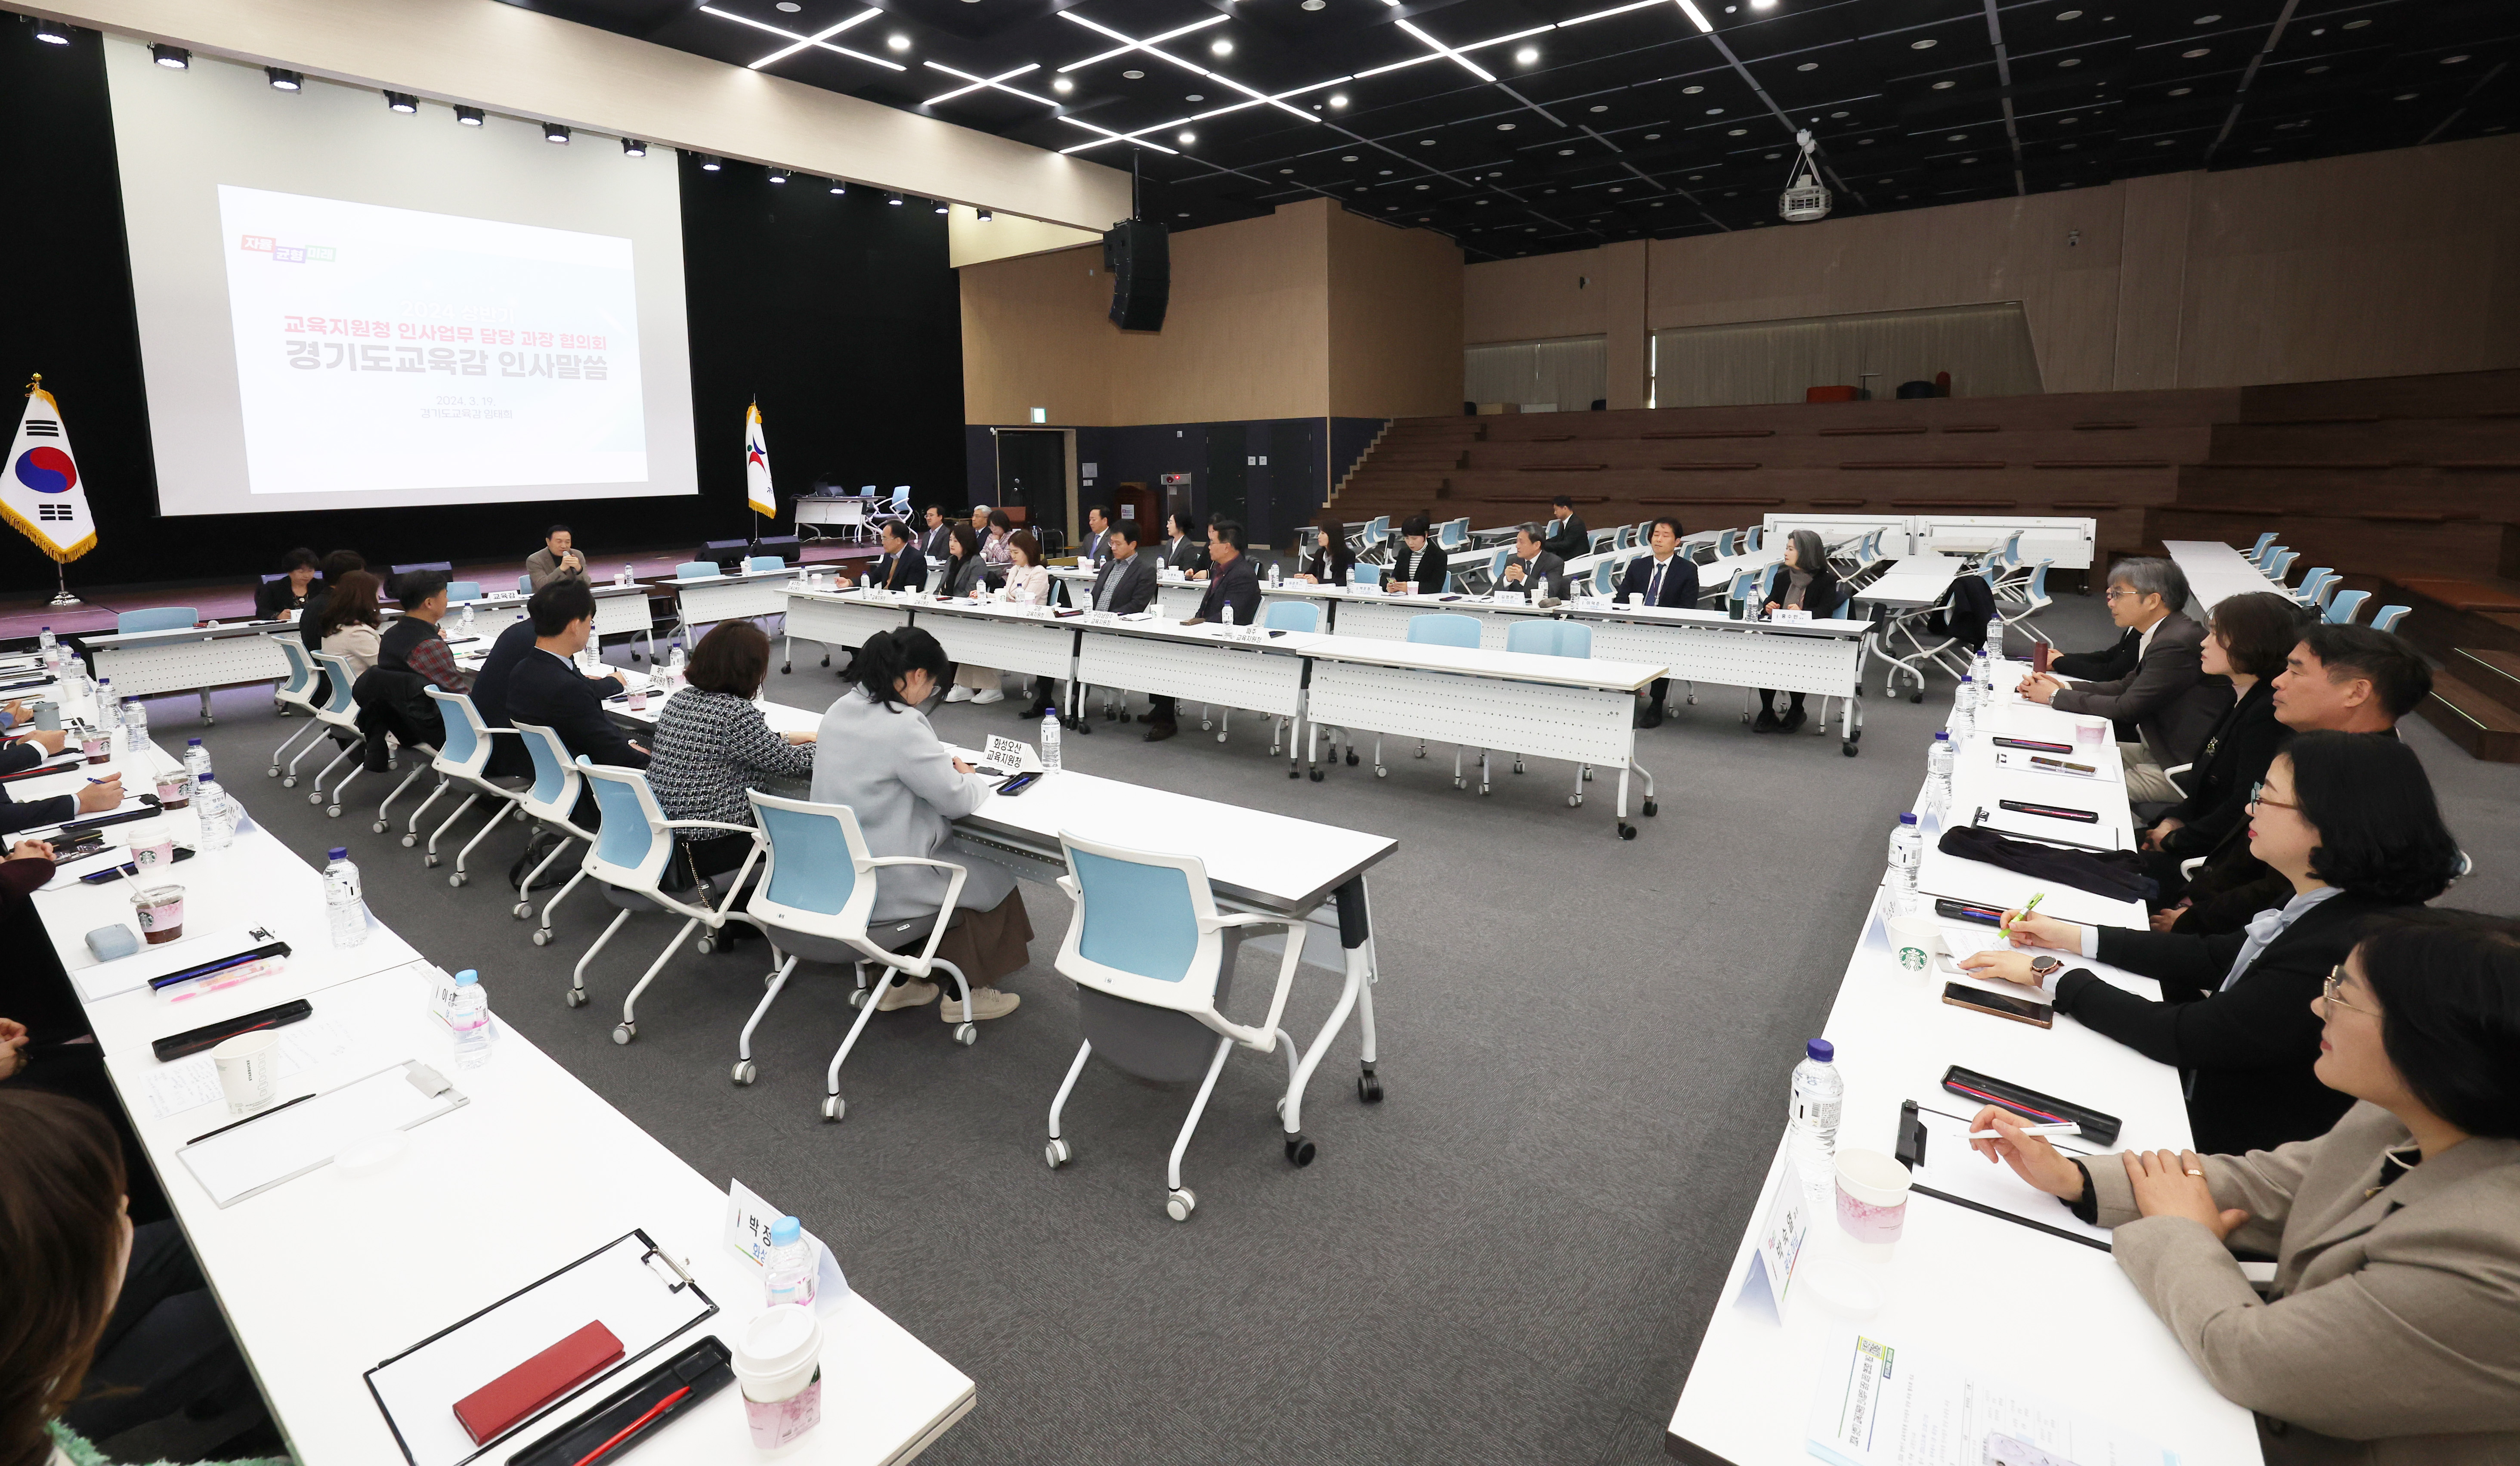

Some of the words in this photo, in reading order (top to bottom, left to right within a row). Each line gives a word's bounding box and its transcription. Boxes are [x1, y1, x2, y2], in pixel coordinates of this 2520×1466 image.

[244, 237, 273, 251] 자율
[276, 248, 304, 261] 균형
[307, 247, 333, 260] 미래
[400, 300, 456, 320] 2024
[461, 303, 515, 325] 상반기
[284, 315, 390, 338] 교육지원청
[398, 322, 474, 344] 인사업무
[480, 328, 515, 346] 담당
[520, 330, 554, 348] 과장
[559, 332, 607, 351] 협의회
[285, 340, 489, 376] 경기도교육감
[498, 351, 608, 381] 인사말씀
[436, 396, 467, 406] 2024.
[420, 408, 482, 419] 경기도교육감
[484, 409, 513, 420] 임태희
[1236, 635, 1262, 643] 교육지원청
[657, 667, 664, 675] 부천
[650, 675, 666, 686] 교육지원청
[993, 738, 1021, 754] 화성오산
[986, 750, 1021, 768] 교육지원청
